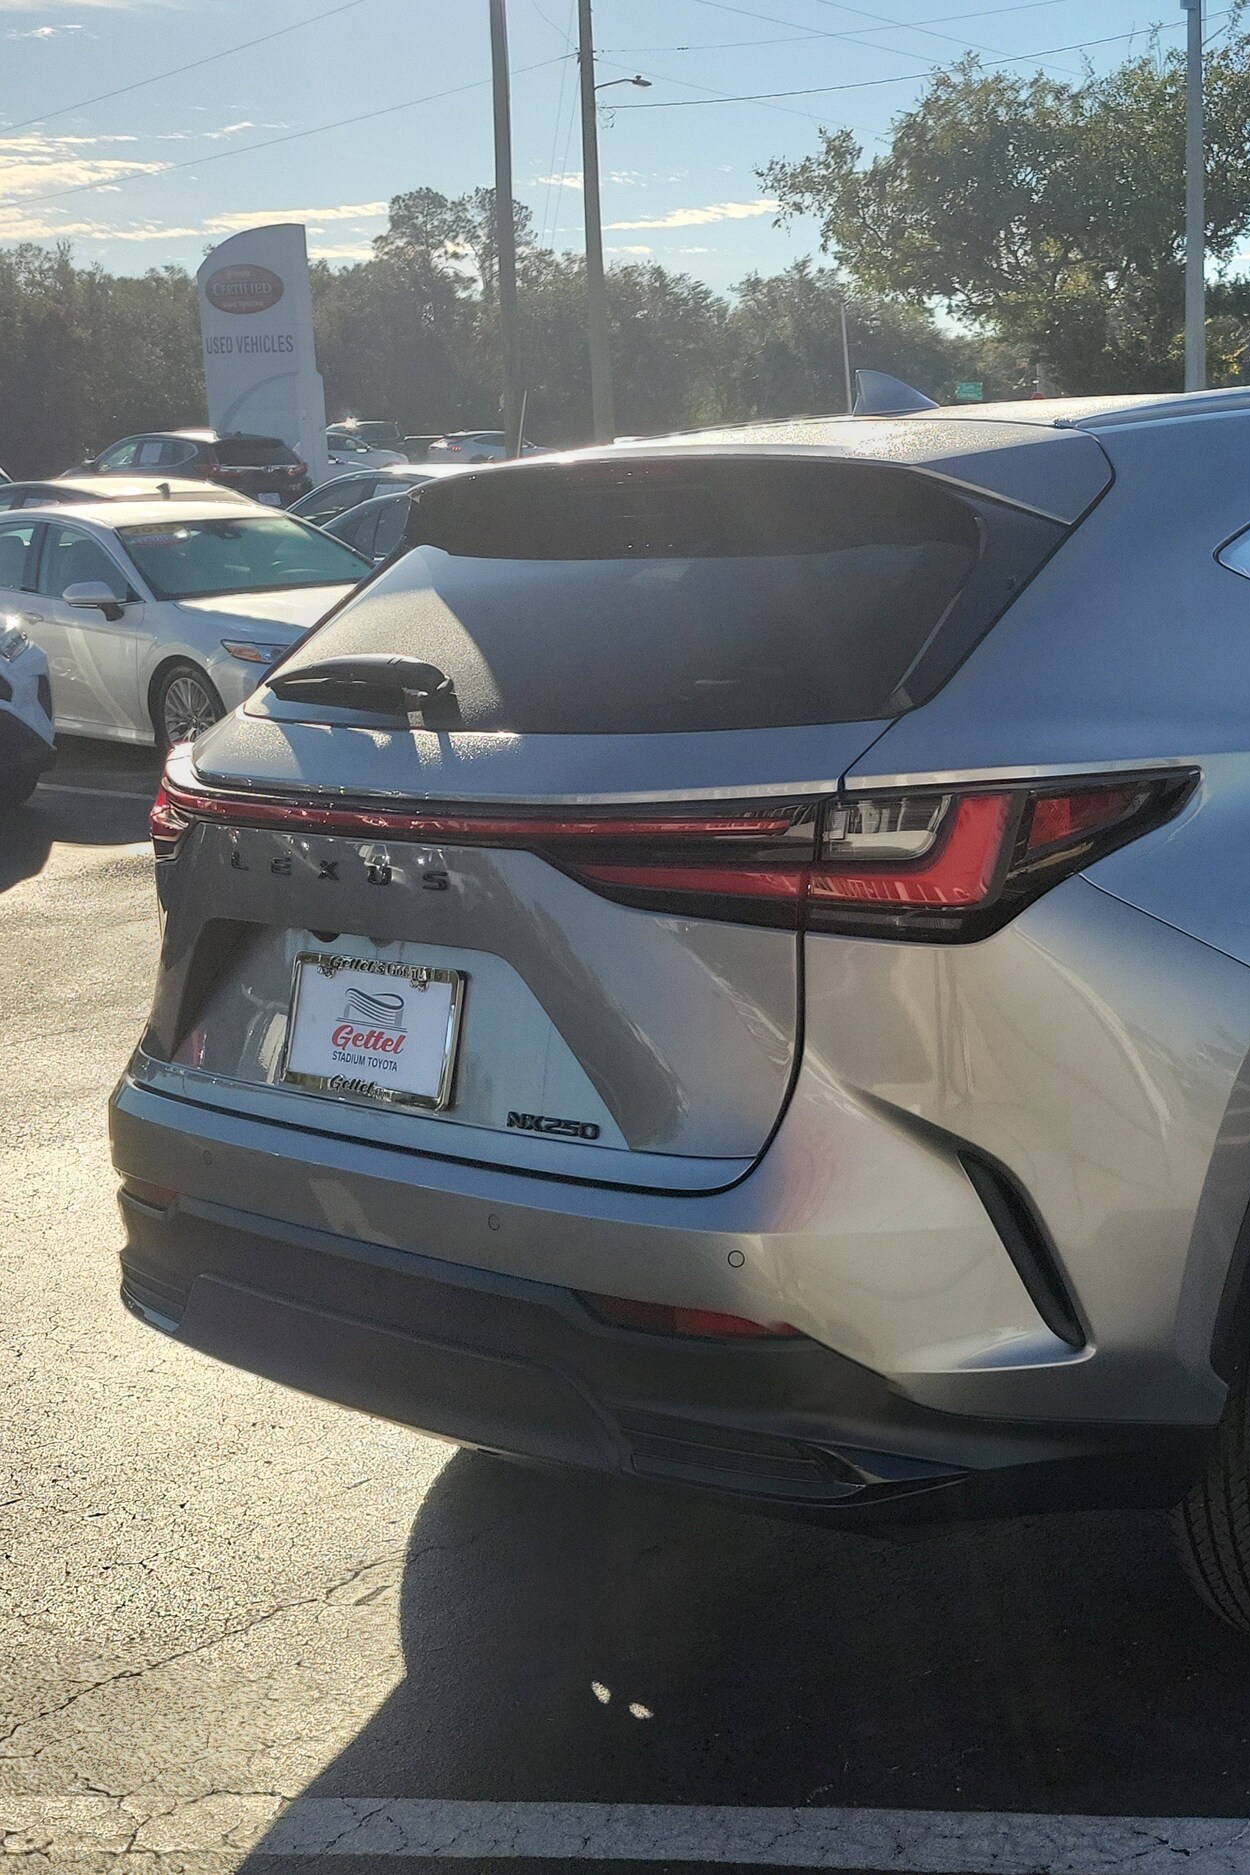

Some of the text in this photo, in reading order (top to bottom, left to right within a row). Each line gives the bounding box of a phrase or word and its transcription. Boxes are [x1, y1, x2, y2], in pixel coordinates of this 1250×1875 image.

[206, 334, 294, 354] USED VEHICLES
[231, 850, 450, 891] LEXUS
[331, 1024, 406, 1055] Gettel
[332, 1051, 398, 1072] STADIUM TOYOTA
